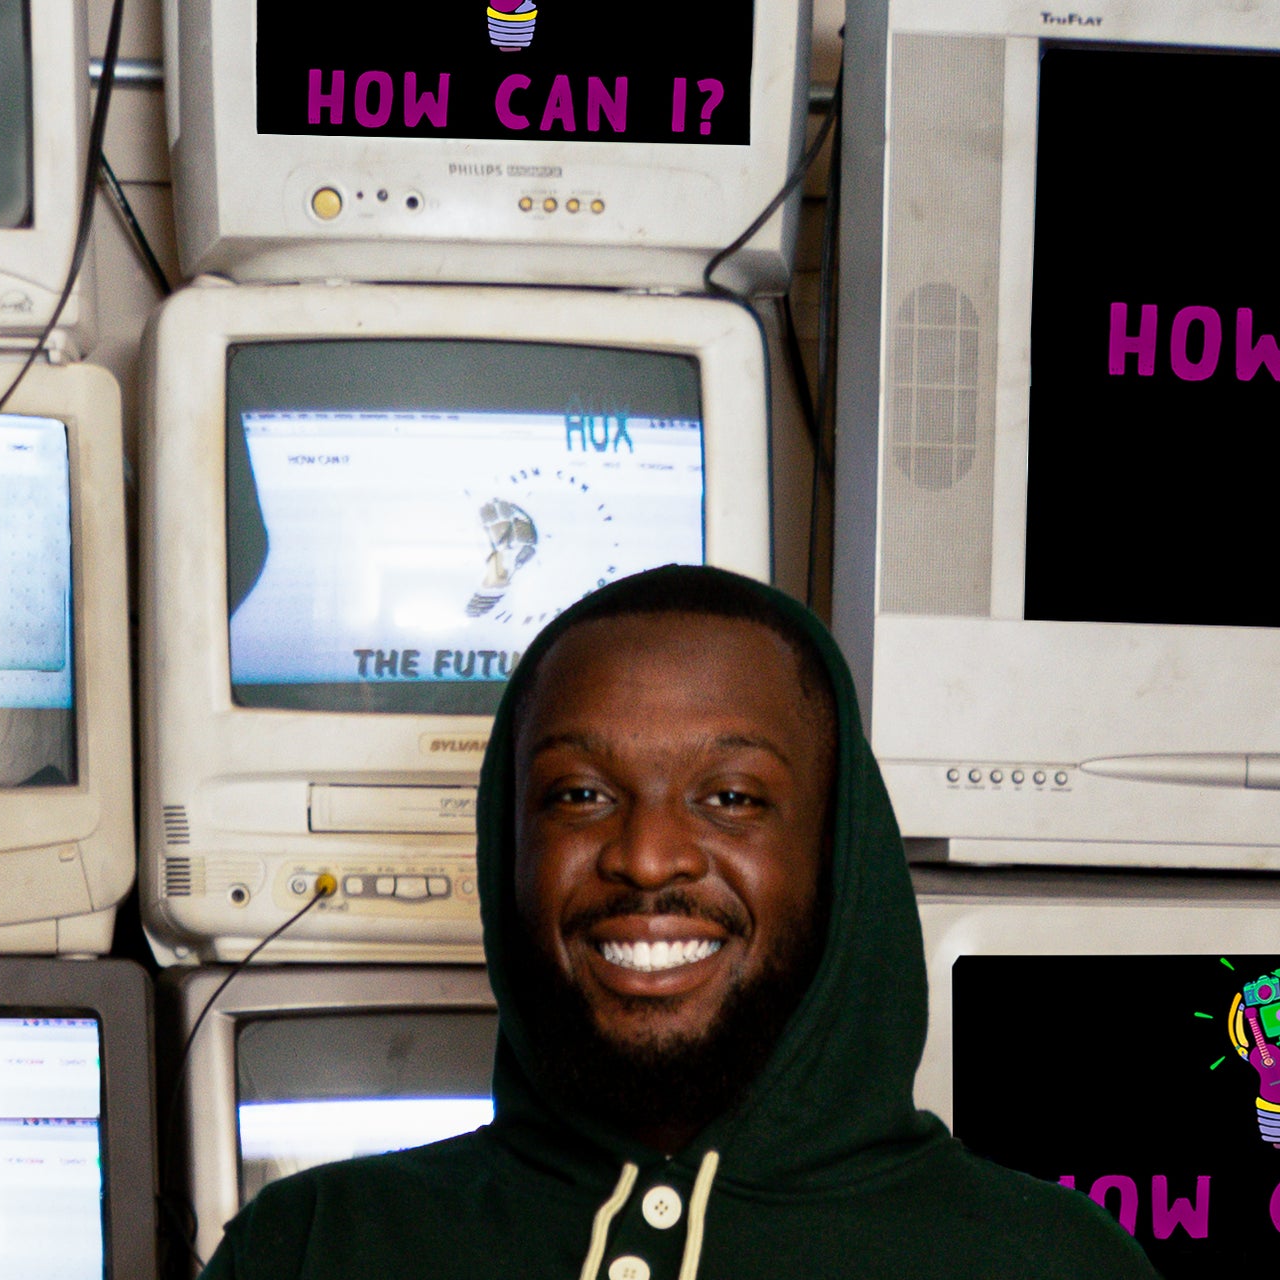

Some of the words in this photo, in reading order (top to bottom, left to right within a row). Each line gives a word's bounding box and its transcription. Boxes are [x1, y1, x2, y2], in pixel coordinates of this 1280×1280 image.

[308, 68, 450, 129] HOW
[495, 73, 627, 133] CAN
[672, 77, 725, 136] I?
[448, 162, 503, 177] PHILIPS
[354, 648, 420, 678] THE
[1059, 1174, 1212, 1240] OW
